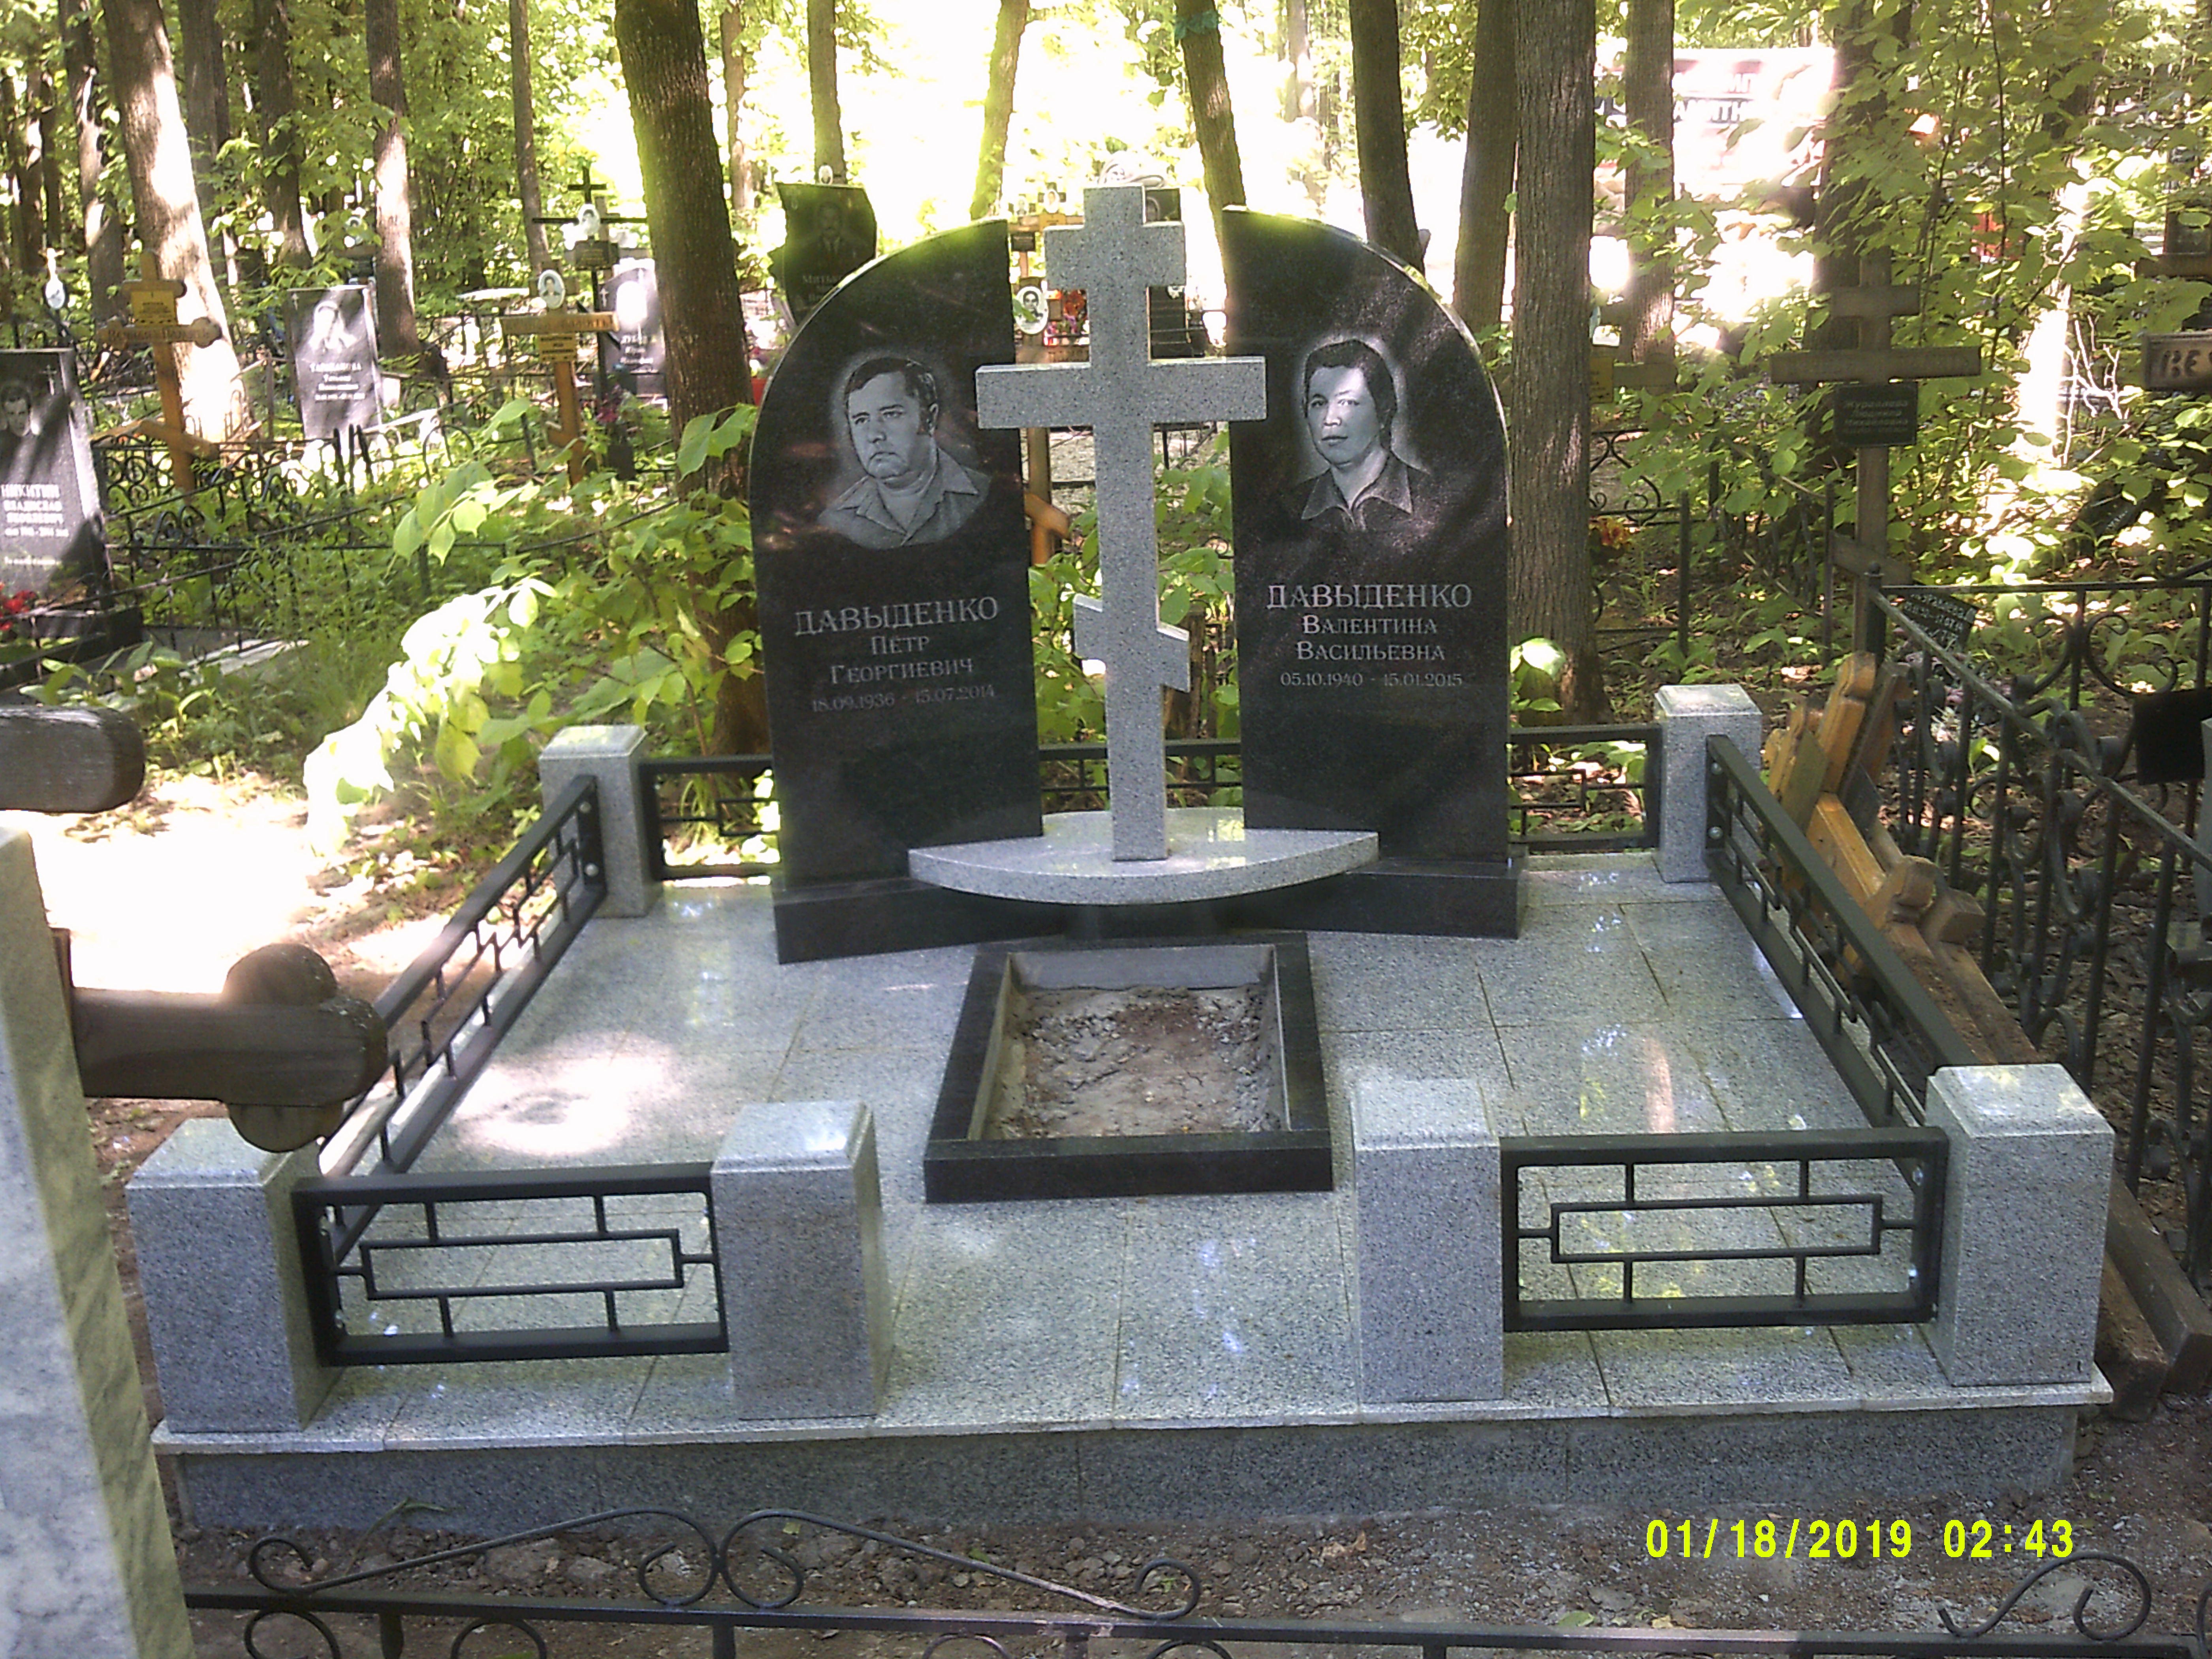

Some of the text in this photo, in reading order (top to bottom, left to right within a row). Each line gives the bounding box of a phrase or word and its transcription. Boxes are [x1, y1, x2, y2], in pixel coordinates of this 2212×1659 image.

[2160, 350, 2212, 378] ВЕ
[1267, 584, 1472, 609] ДАВЫДЕНКО
[795, 596, 998, 636] ДАВЫДЕНКО
[1281, 673, 1363, 687] 05.10.1940
[1384, 673, 1462, 687] 15.01.2015
